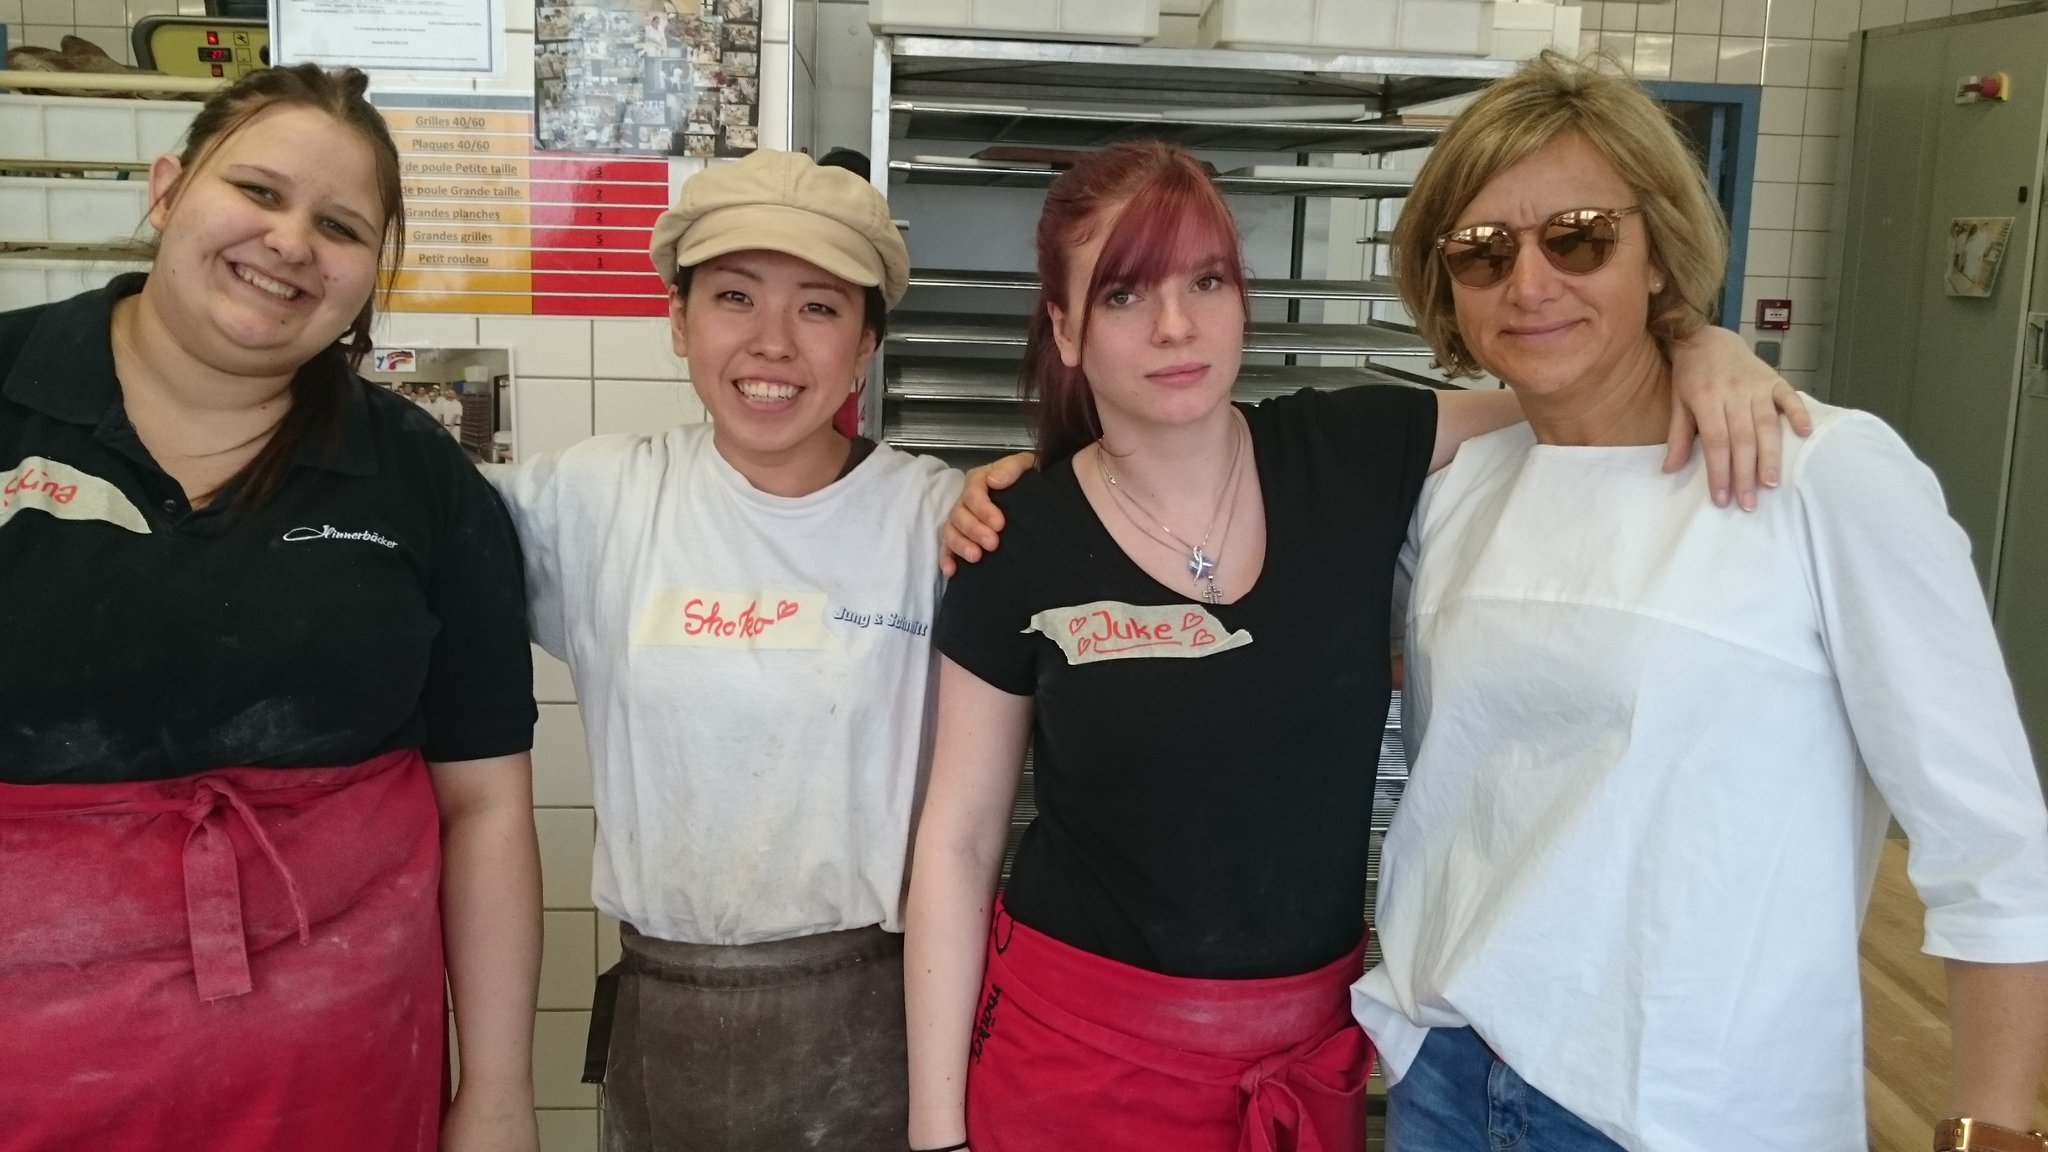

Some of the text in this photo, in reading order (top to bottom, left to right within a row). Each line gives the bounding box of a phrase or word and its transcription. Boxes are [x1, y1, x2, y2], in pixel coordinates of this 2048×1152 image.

[415, 116, 485, 128] Grilles 40/60
[412, 139, 490, 151] Plaques 40/60
[405, 162, 518, 175] de poule Petite taille
[417, 185, 447, 198] poule
[451, 186, 490, 196] Grande
[494, 187, 520, 197] taille
[405, 208, 500, 221] Grandes planches
[413, 231, 493, 243] Grandes grilles
[418, 253, 489, 264] Petit rouleau
[684, 599, 774, 639] Shoko
[832, 605, 871, 628] Jung
[873, 613, 884, 626] &
[1092, 610, 1173, 642] Juke
